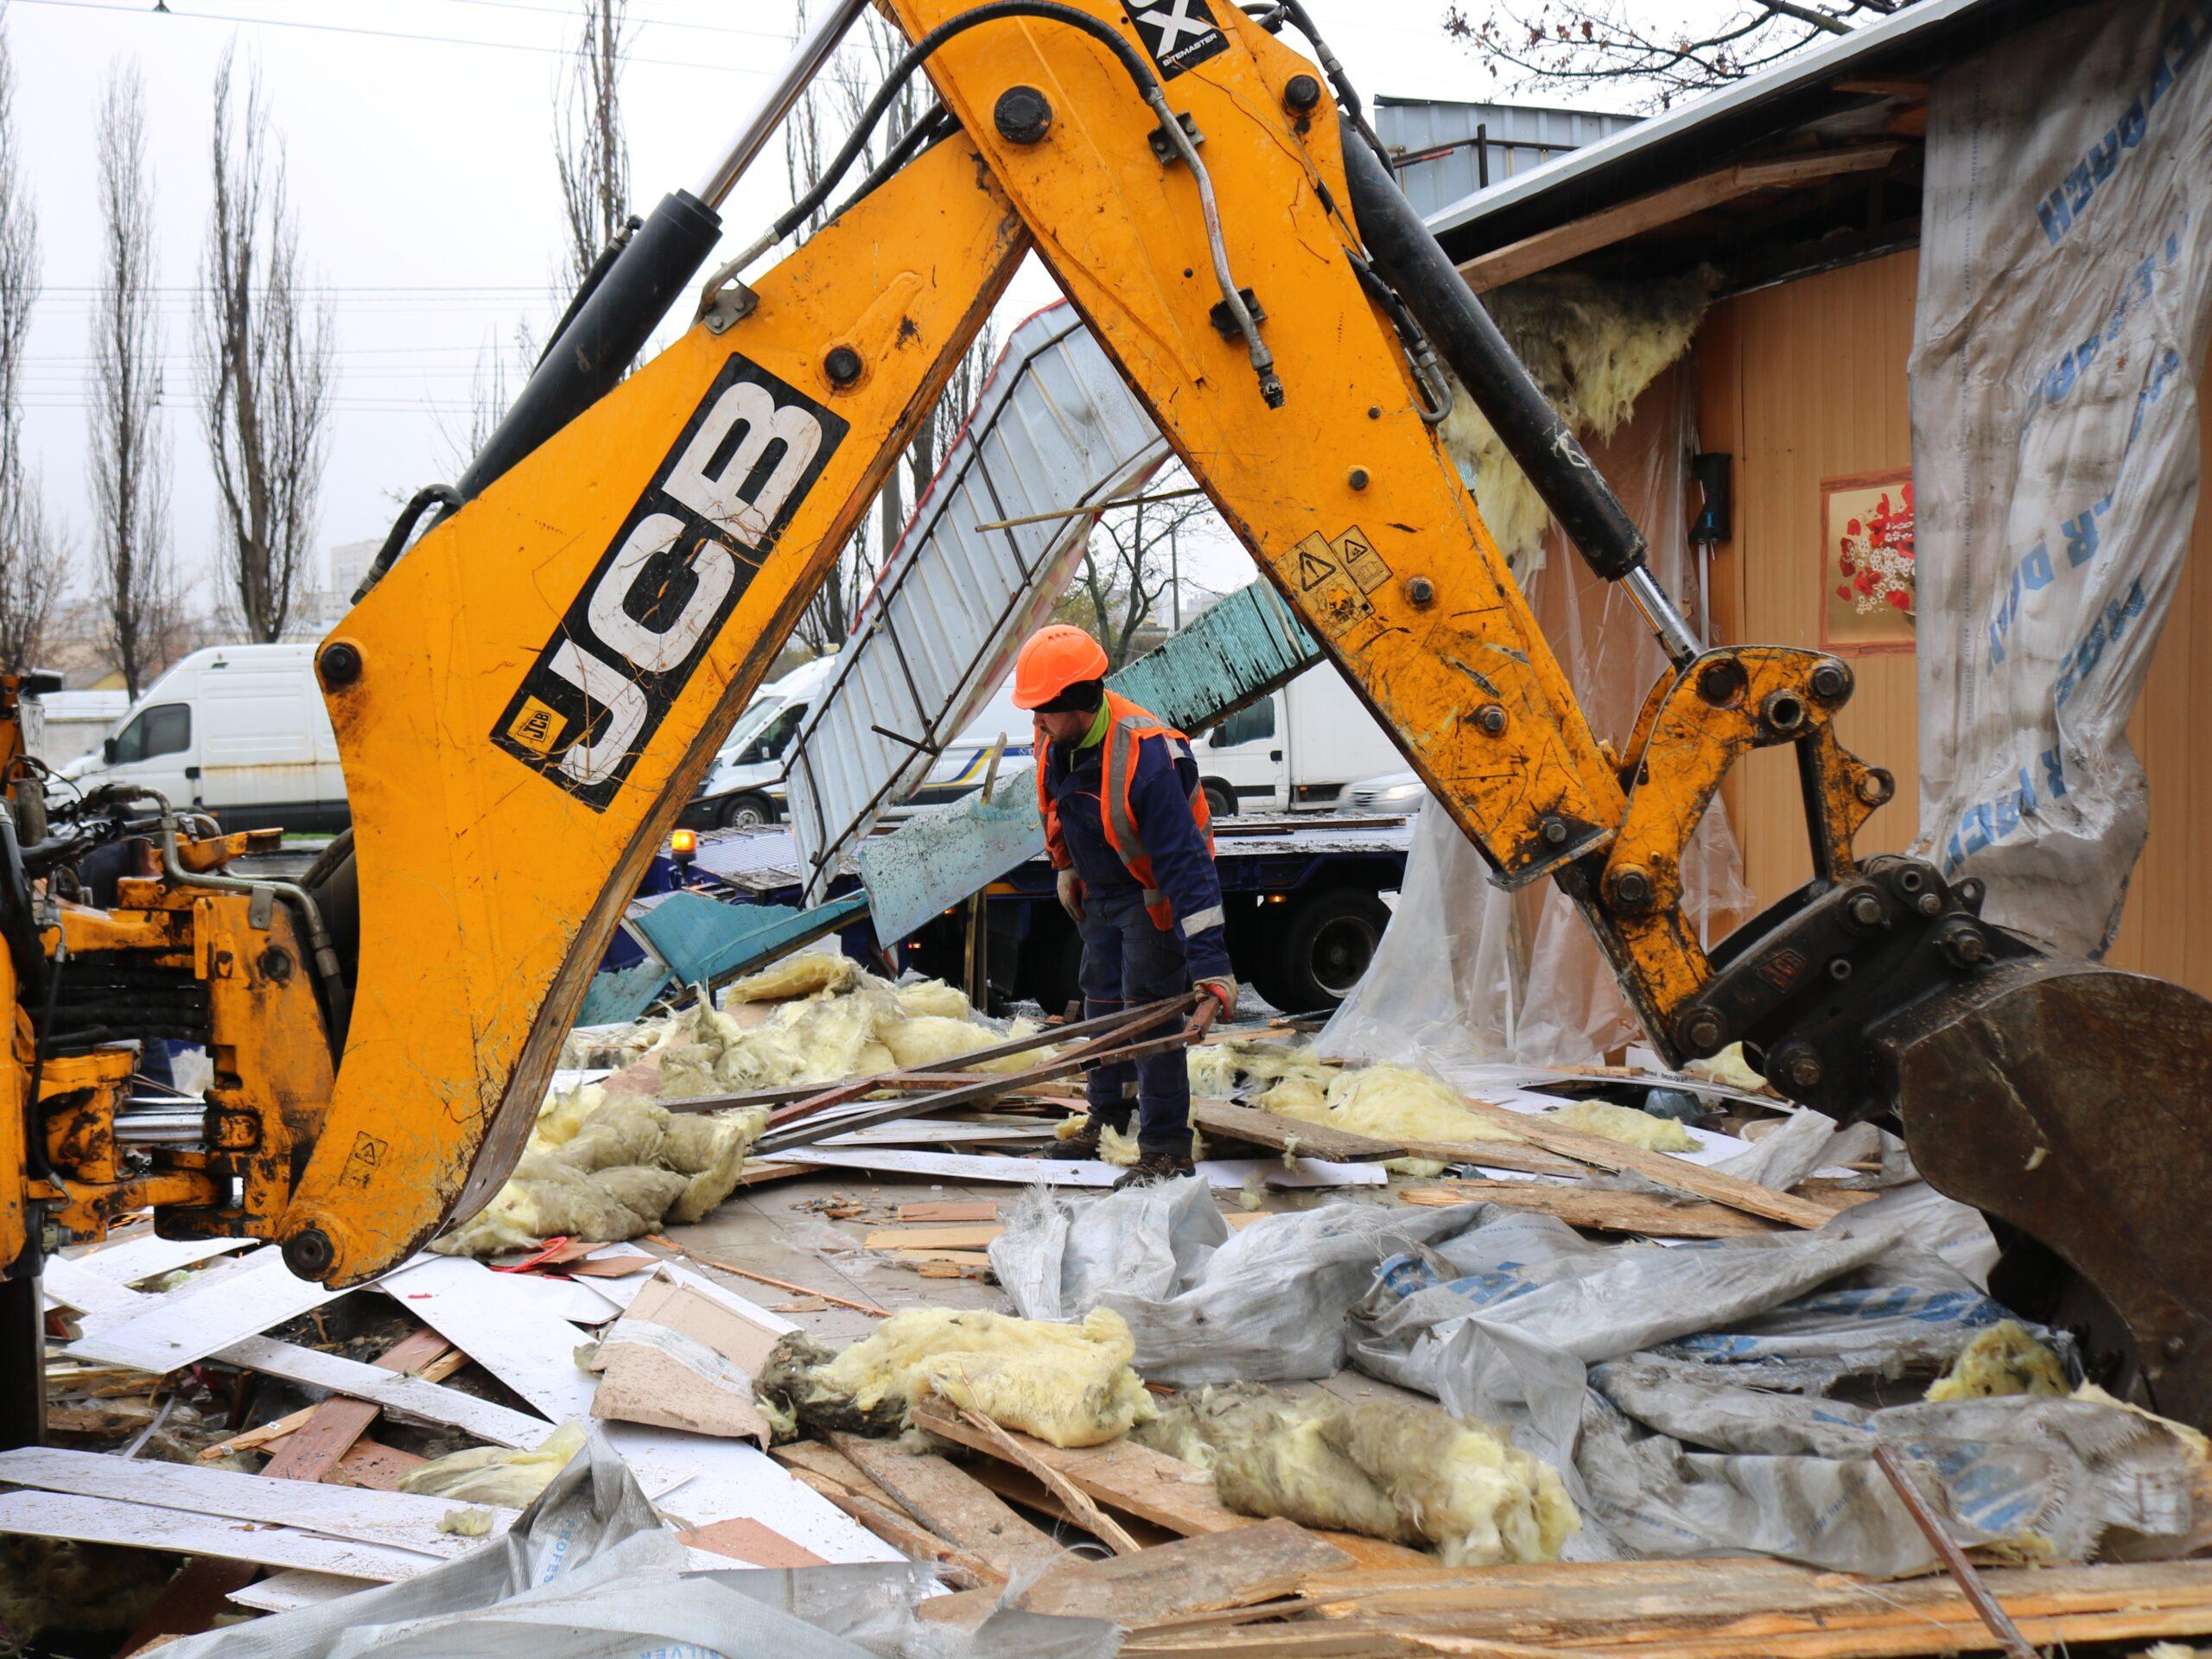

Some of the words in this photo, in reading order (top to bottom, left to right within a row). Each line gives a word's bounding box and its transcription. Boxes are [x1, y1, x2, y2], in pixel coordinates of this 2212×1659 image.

[1128, 0, 1212, 59] X
[1162, 33, 1217, 67] SITEMASTER
[549, 382, 823, 785] JCB
[523, 713, 550, 739] JCB
